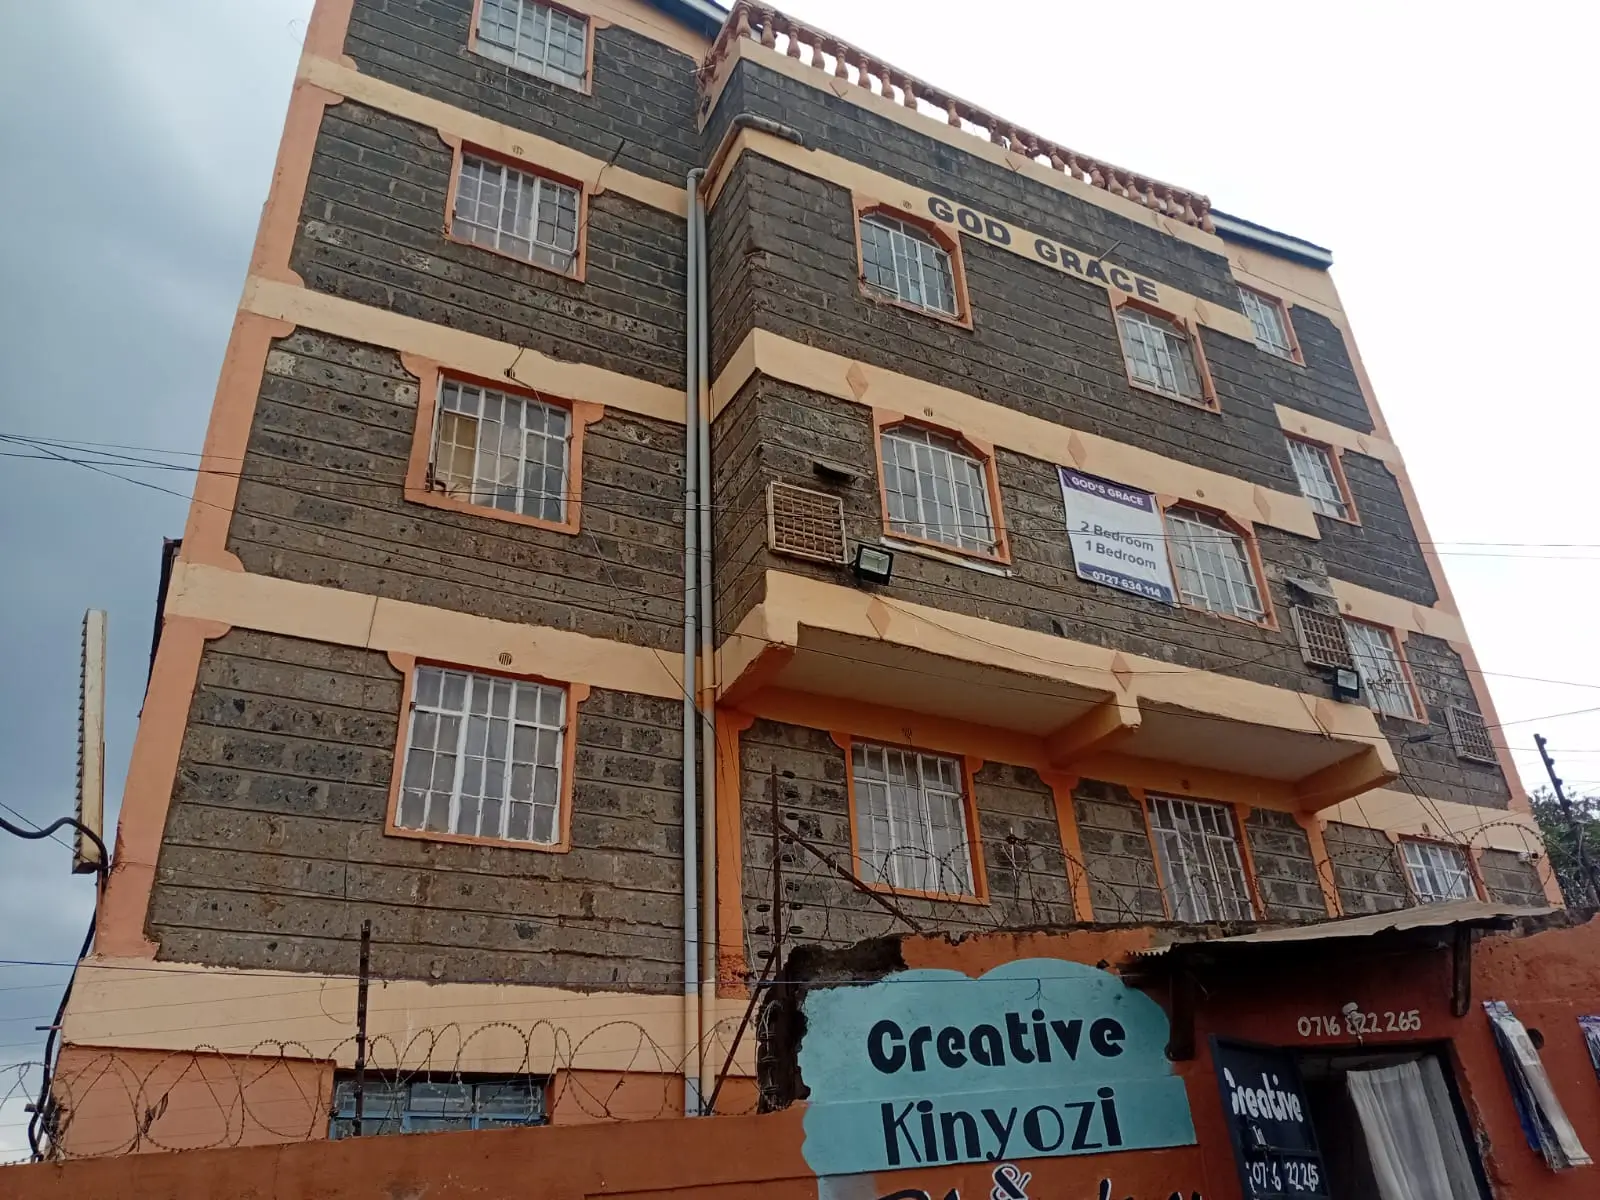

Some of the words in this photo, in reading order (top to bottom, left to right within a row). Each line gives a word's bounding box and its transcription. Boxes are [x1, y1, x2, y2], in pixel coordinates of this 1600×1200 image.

[928, 197, 1011, 245] GOD
[1034, 239, 1159, 303] GRACE
[1071, 476, 1106, 494] GOD'S
[1107, 488, 1144, 506] GRACE
[1080, 521, 1090, 532] 2
[1093, 524, 1154, 552] Bedroom
[1085, 540, 1092, 551] 1
[1096, 542, 1157, 570] Bedroom
[1092, 571, 1118, 585] 0727
[1121, 579, 1143, 592] 634
[1144, 586, 1162, 598] 114
[1297, 1015, 1341, 1037] 0716
[1384, 1009, 1421, 1032] 265
[867, 1008, 1126, 1074] Creative
[881, 1087, 1123, 1166] Kinyozi
